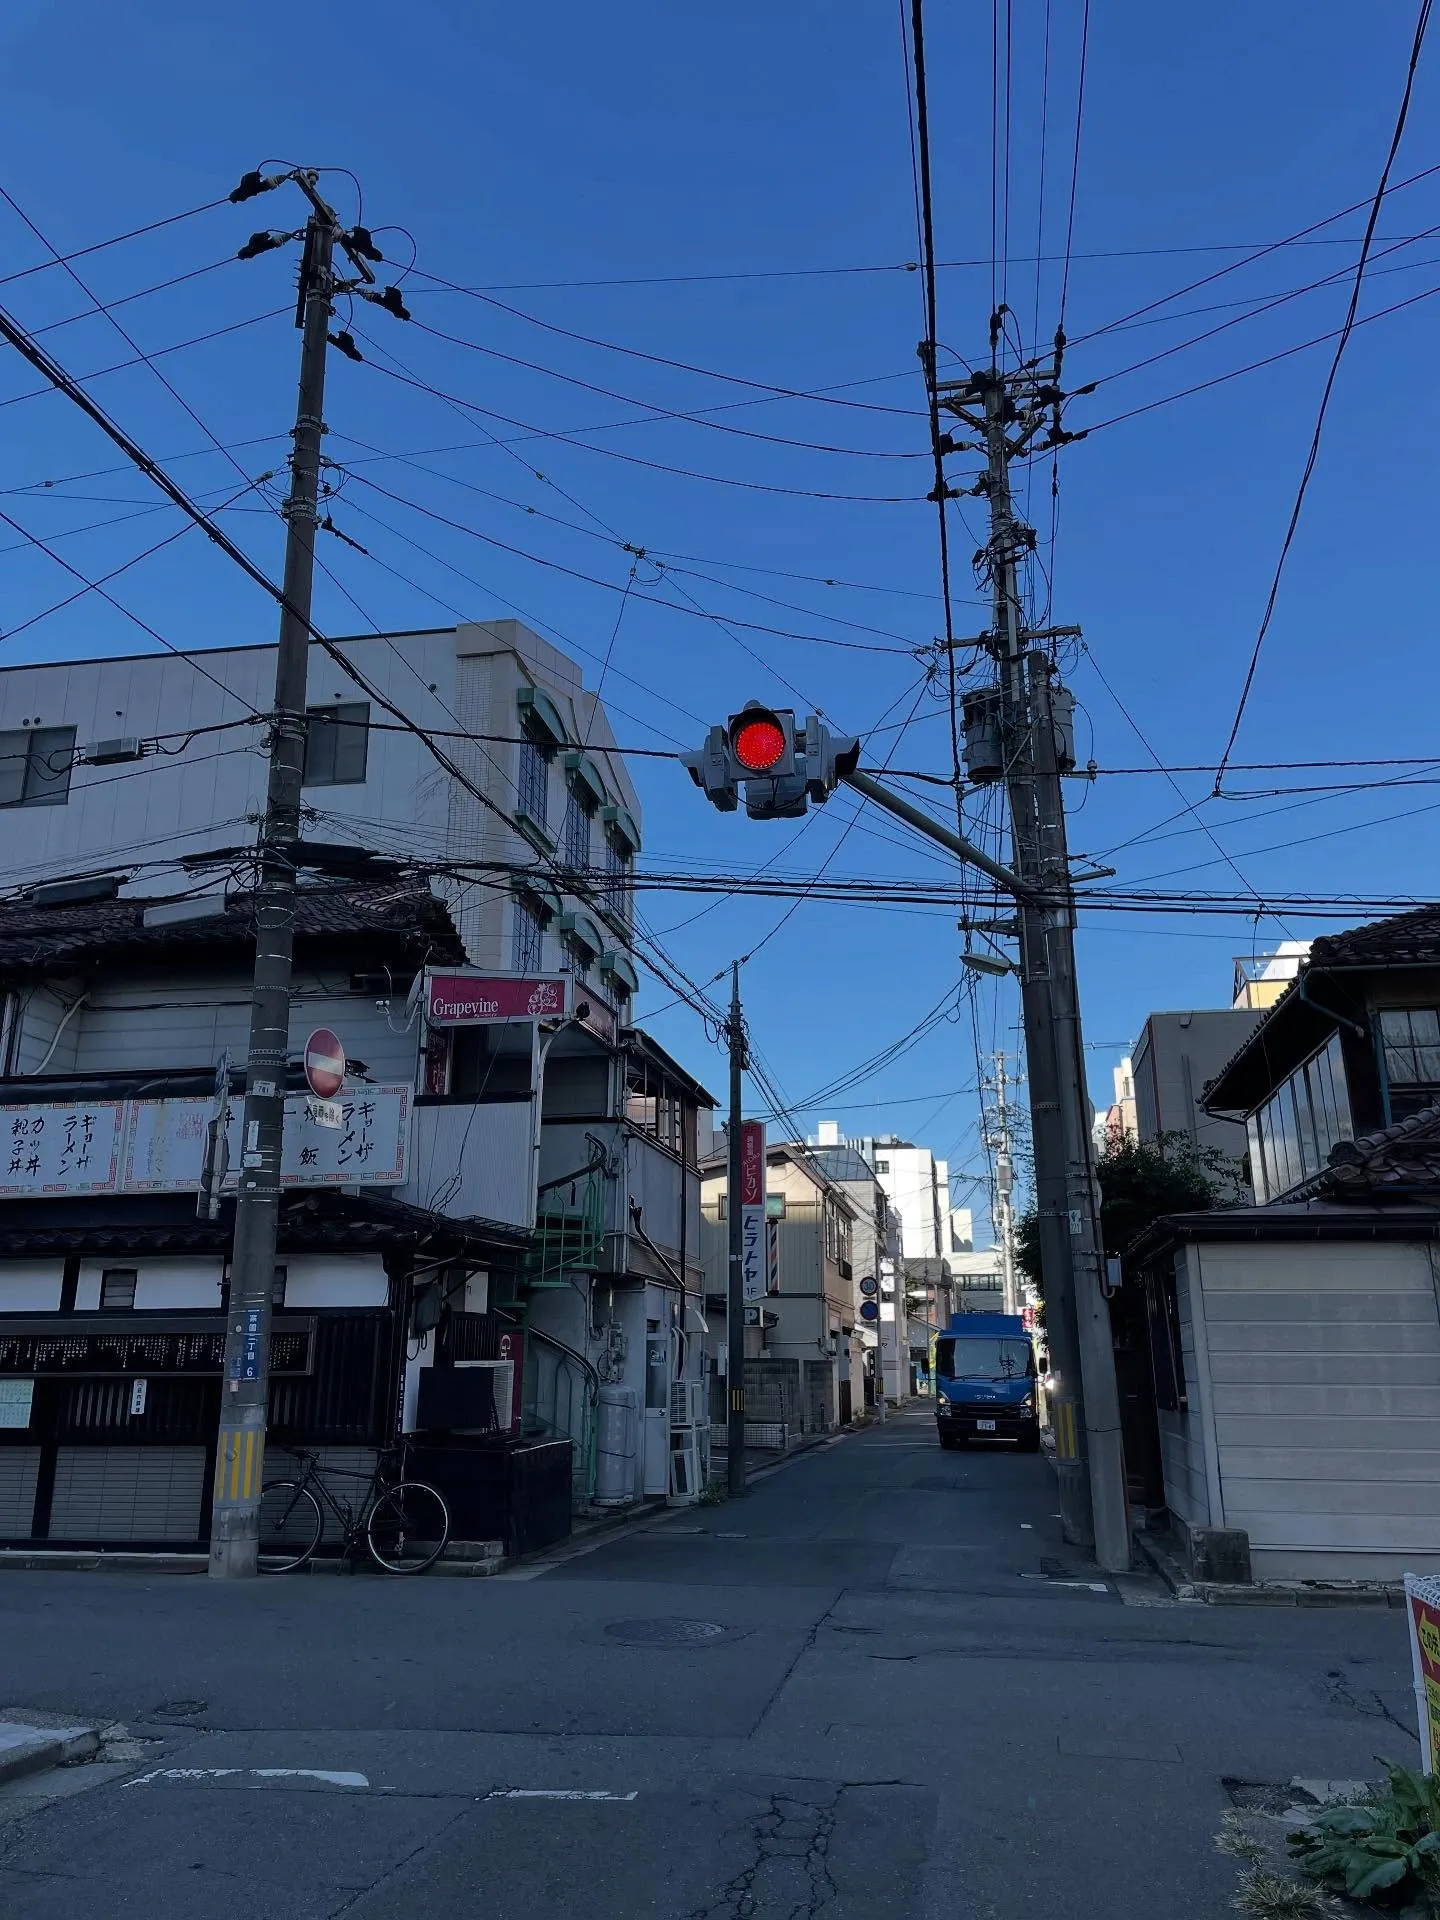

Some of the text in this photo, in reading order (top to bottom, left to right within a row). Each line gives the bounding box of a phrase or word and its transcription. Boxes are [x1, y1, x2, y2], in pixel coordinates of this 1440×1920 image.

[432, 996, 499, 1018] Grapevine
[57, 1115, 78, 1176] ラーメン
[337, 1102, 356, 1165] ラーメン
[355, 1101, 376, 1164] ギョーザ
[743, 1215, 758, 1283] ヒラトヤ
[746, 1286, 757, 1296] 1F
[744, 1308, 758, 1325] P
[246, 1366, 254, 1377] 6
